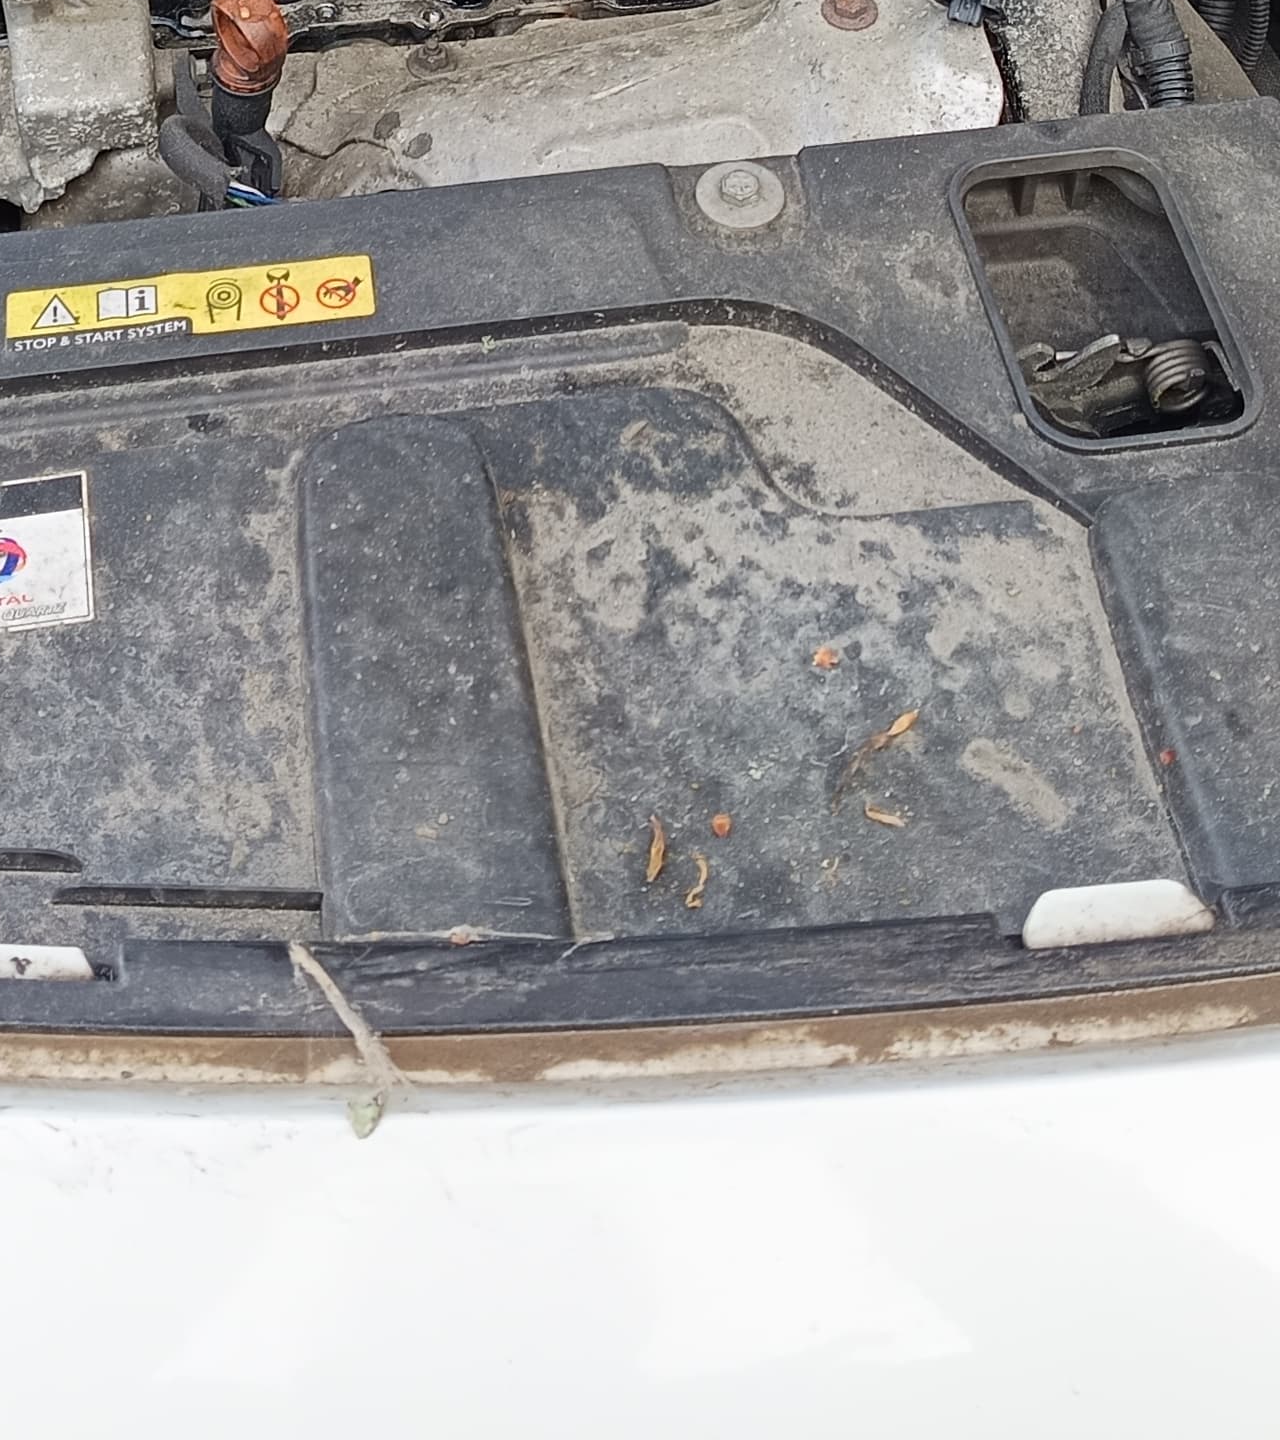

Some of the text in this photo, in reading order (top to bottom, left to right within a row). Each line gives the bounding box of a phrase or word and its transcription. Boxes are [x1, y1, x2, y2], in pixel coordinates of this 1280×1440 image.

[14, 319, 187, 352] STOP & START SYSTEM
